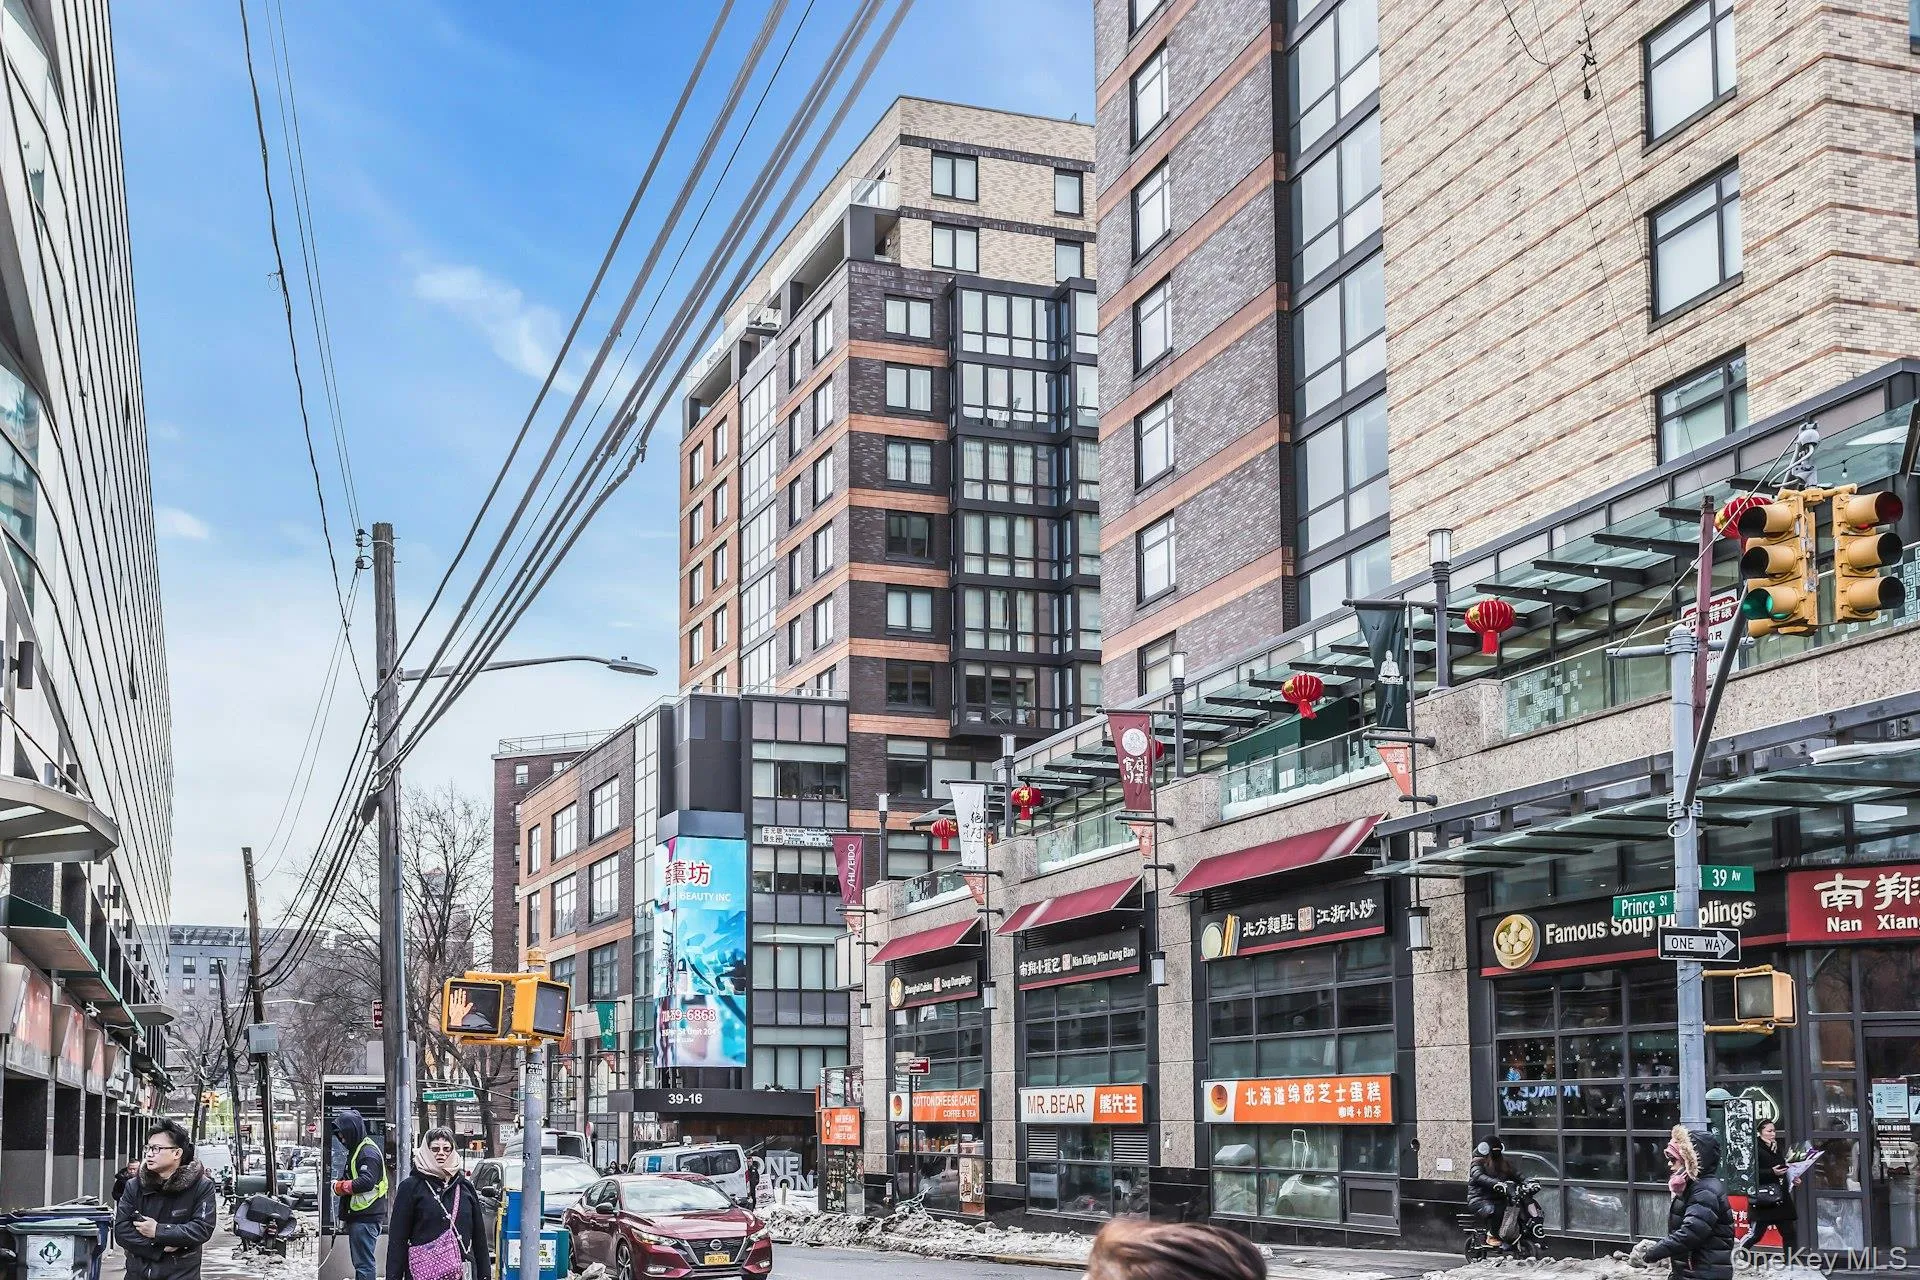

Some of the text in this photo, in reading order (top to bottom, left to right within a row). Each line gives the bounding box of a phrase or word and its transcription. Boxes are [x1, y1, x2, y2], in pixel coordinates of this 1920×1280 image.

[847, 843, 856, 891] SHISEIDO
[1712, 869, 1741, 887] 39 Av
[680, 892, 731, 902] BEAUTY INC
[1621, 894, 1668, 916] Prince St
[1545, 920, 1608, 945] Famous
[1610, 915, 1656, 938] Soup
[1826, 914, 1920, 933] Nan Xian
[1671, 937, 1728, 951] ONE WAY
[668, 1093, 703, 1104] 39-16
[912, 1094, 976, 1107] COTTON CHEESE CAKE
[1027, 1094, 1085, 1114] MR.BEAR
[1099, 1093, 1137, 1114] 熊先生
[943, 1109, 961, 1118] COFFEE
[966, 1109, 976, 1118] TEA
[1877, 1124, 1910, 1132] OPEN HOURS
